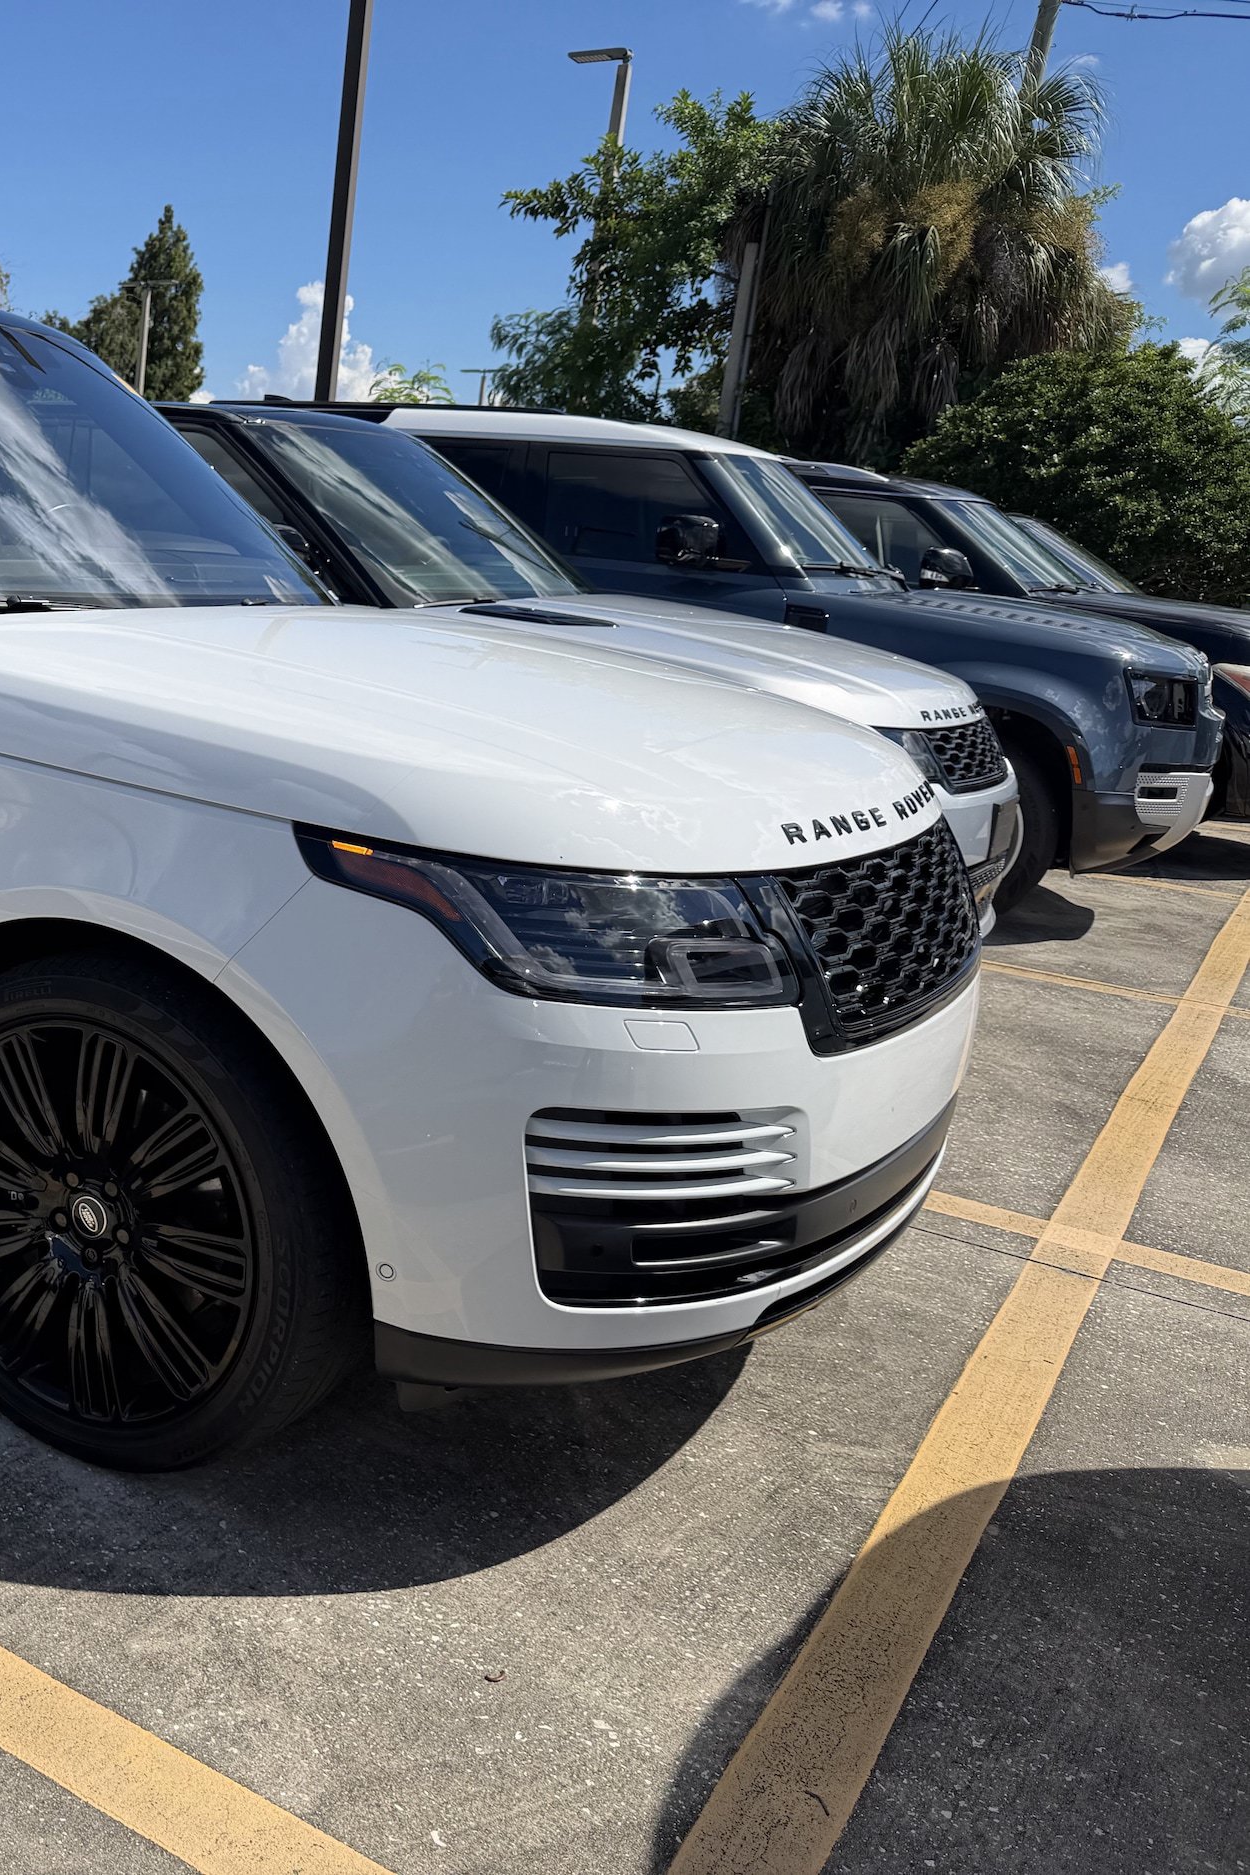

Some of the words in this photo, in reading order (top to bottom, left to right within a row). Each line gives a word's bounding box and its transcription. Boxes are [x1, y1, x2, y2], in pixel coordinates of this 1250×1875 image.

[920, 706, 967, 721] RANGE
[781, 807, 887, 845] RANGE
[239, 1235, 293, 1416] SCORPION
